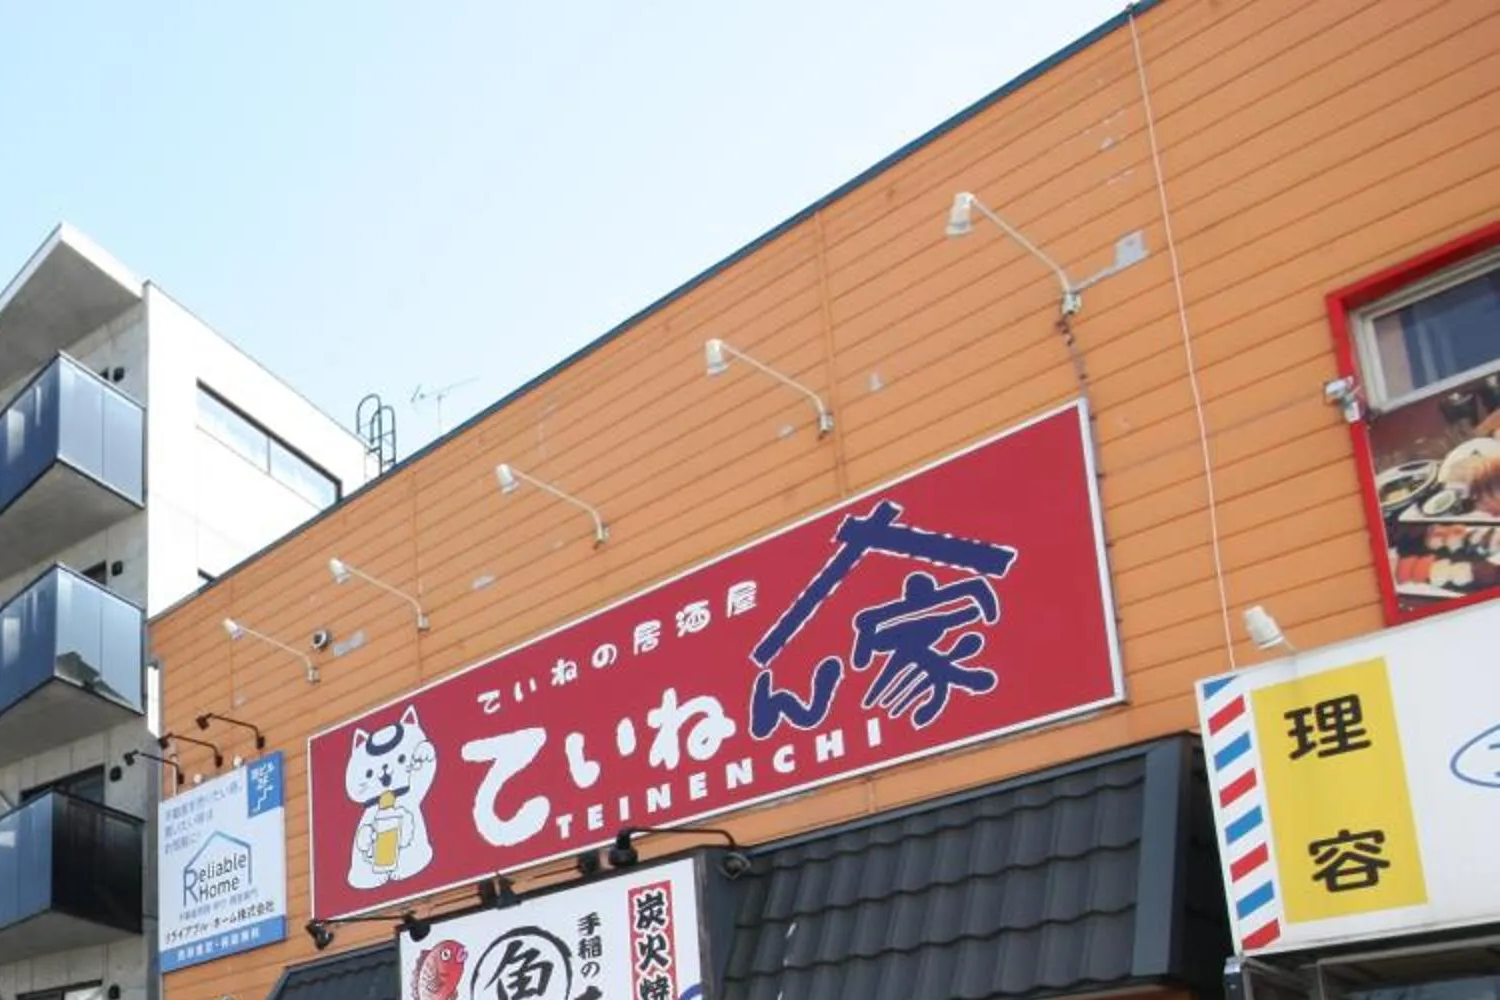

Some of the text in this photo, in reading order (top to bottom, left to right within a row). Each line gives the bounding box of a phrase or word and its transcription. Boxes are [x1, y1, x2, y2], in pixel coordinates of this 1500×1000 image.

[477, 581, 758, 713] ていねの居酒屋
[461, 570, 999, 847] ていねん家
[555, 717, 882, 839] TEINENCHI
[1283, 693, 1391, 893] 理容
[183, 853, 247, 906] Reliable
[199, 876, 240, 901] Home
[577, 911, 602, 979] 手稲の
